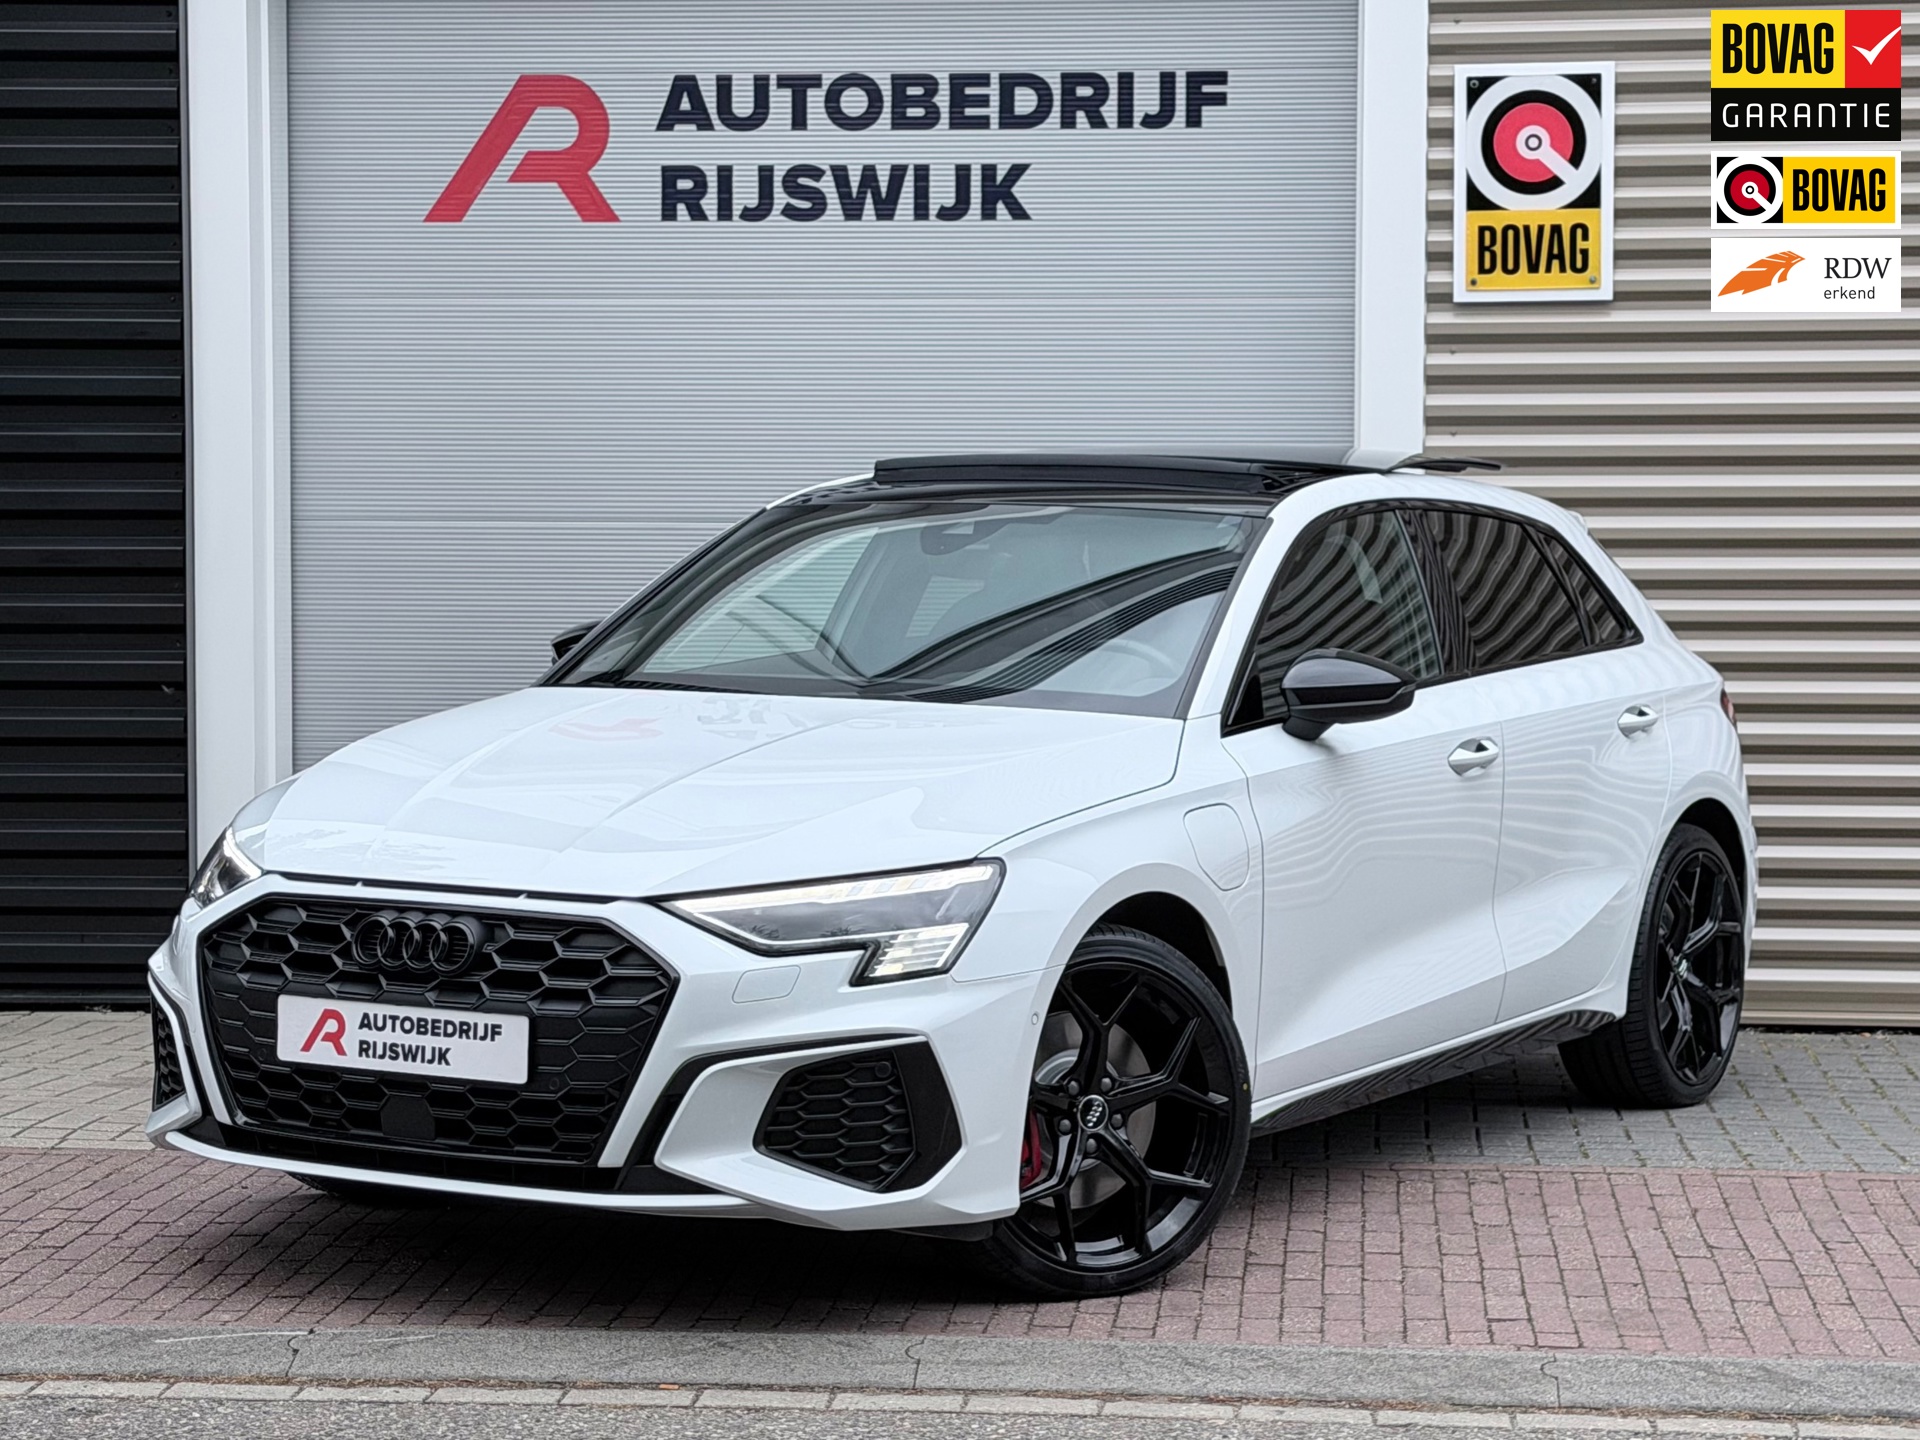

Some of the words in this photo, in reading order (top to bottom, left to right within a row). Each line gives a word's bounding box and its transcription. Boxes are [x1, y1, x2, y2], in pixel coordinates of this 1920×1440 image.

[655, 71, 1228, 131] AUTOBEDRIJF
[660, 163, 1032, 222] RIJSWIJK
[1477, 222, 1589, 275] BOVAG
[357, 1012, 503, 1042] AUTOBEDRIJF
[357, 1039, 452, 1066] RIJSWIJK
